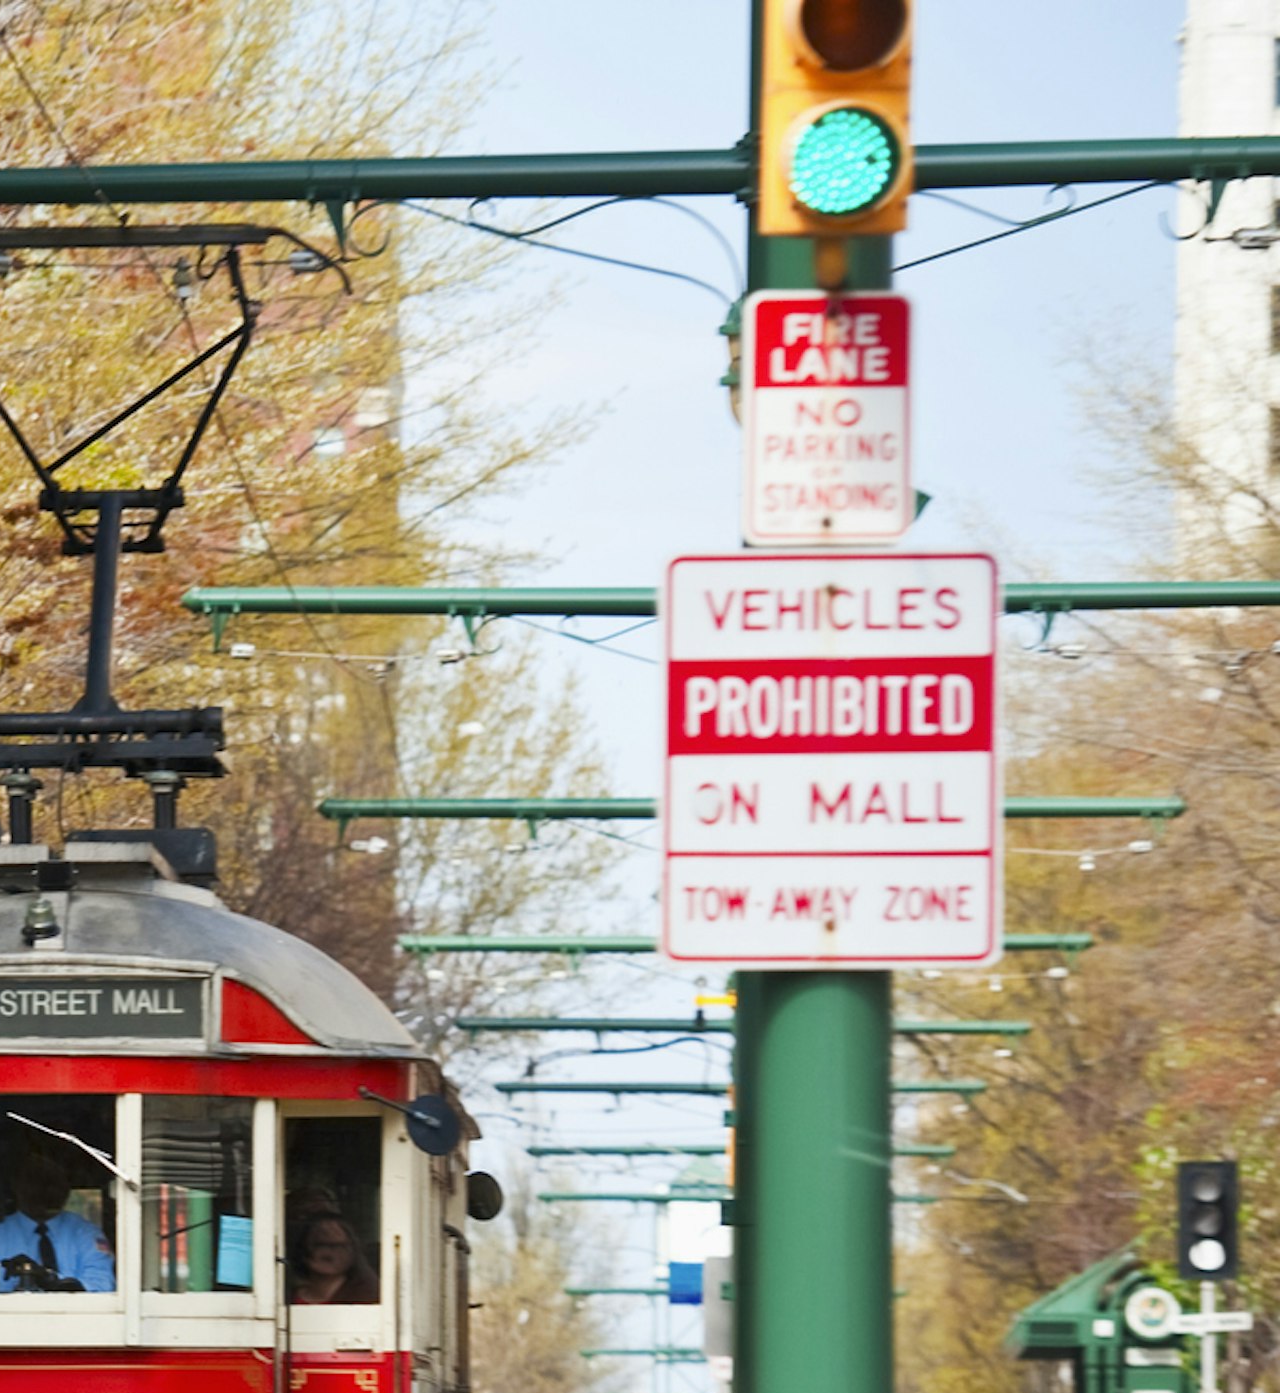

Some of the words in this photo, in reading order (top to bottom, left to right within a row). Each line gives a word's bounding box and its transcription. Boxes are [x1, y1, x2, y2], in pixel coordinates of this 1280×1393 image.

[782, 312, 881, 346] FIRE
[770, 347, 890, 382] LANE
[795, 398, 862, 427] NO
[763, 433, 897, 462] PARKING
[763, 483, 897, 512] STANDING
[704, 587, 962, 630] VEHICLES
[684, 674, 974, 738] PROHIBITED
[696, 782, 759, 825] ON
[808, 782, 964, 823] MALL
[882, 886, 973, 922] ZONE
[112, 989, 184, 1014] MALL
